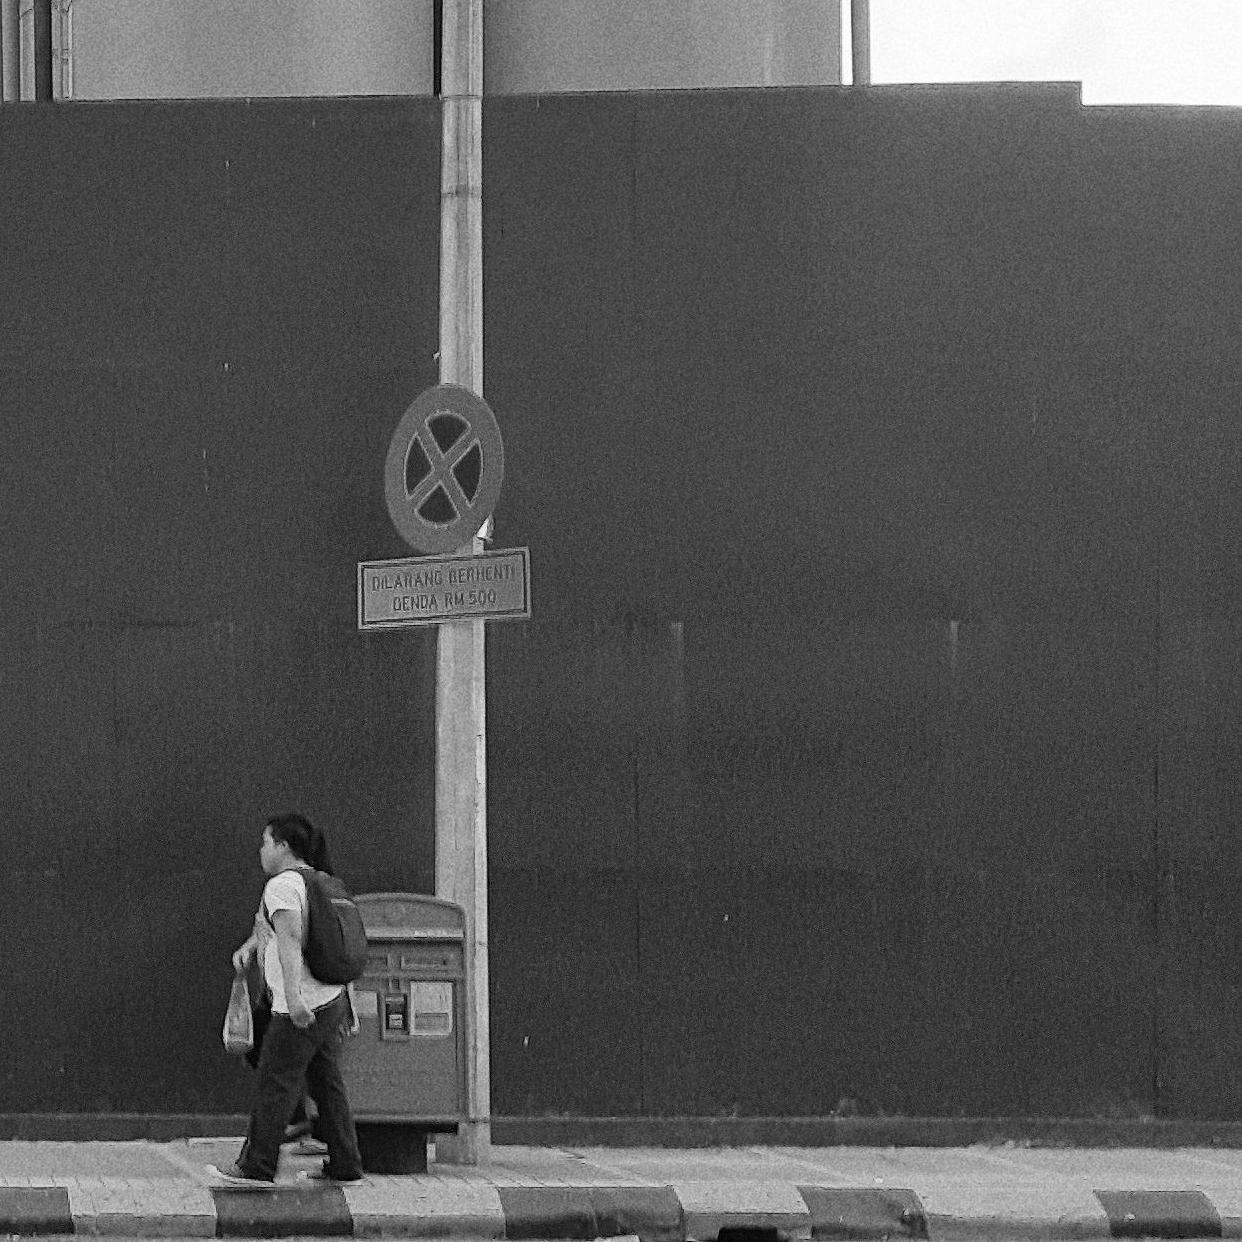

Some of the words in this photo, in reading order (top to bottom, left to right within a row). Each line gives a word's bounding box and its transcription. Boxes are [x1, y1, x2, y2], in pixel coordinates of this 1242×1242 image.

[372, 570, 443, 591] DILARANG
[449, 564, 514, 585] BERHENTI
[393, 594, 438, 611] DENDA
